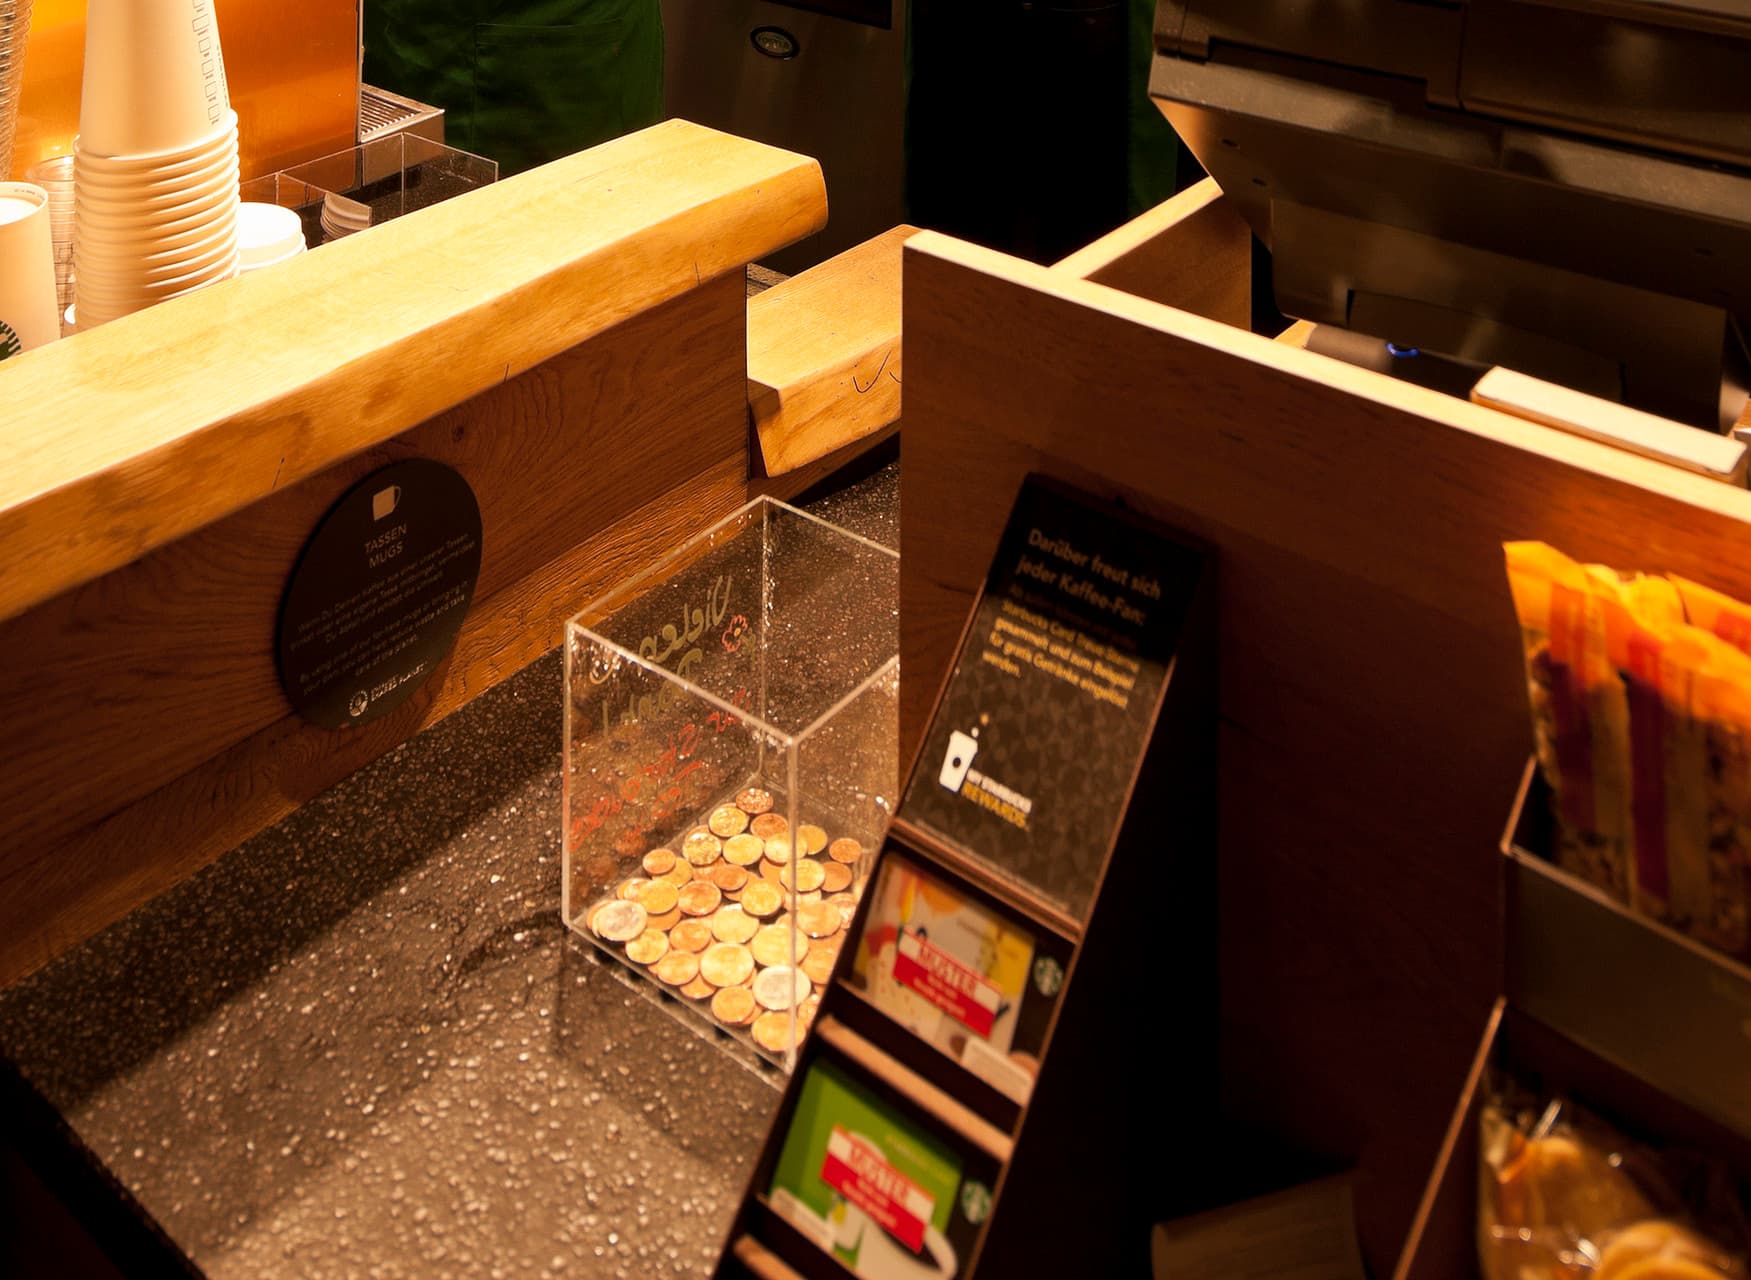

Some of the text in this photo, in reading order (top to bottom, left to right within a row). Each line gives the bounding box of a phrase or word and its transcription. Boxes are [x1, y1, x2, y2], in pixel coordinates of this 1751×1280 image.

[364, 523, 407, 554] TASSEN
[369, 542, 404, 569] MUGS
[1015, 554, 1058, 584] jeder
[1028, 528, 1160, 600] Darüber freut sich
